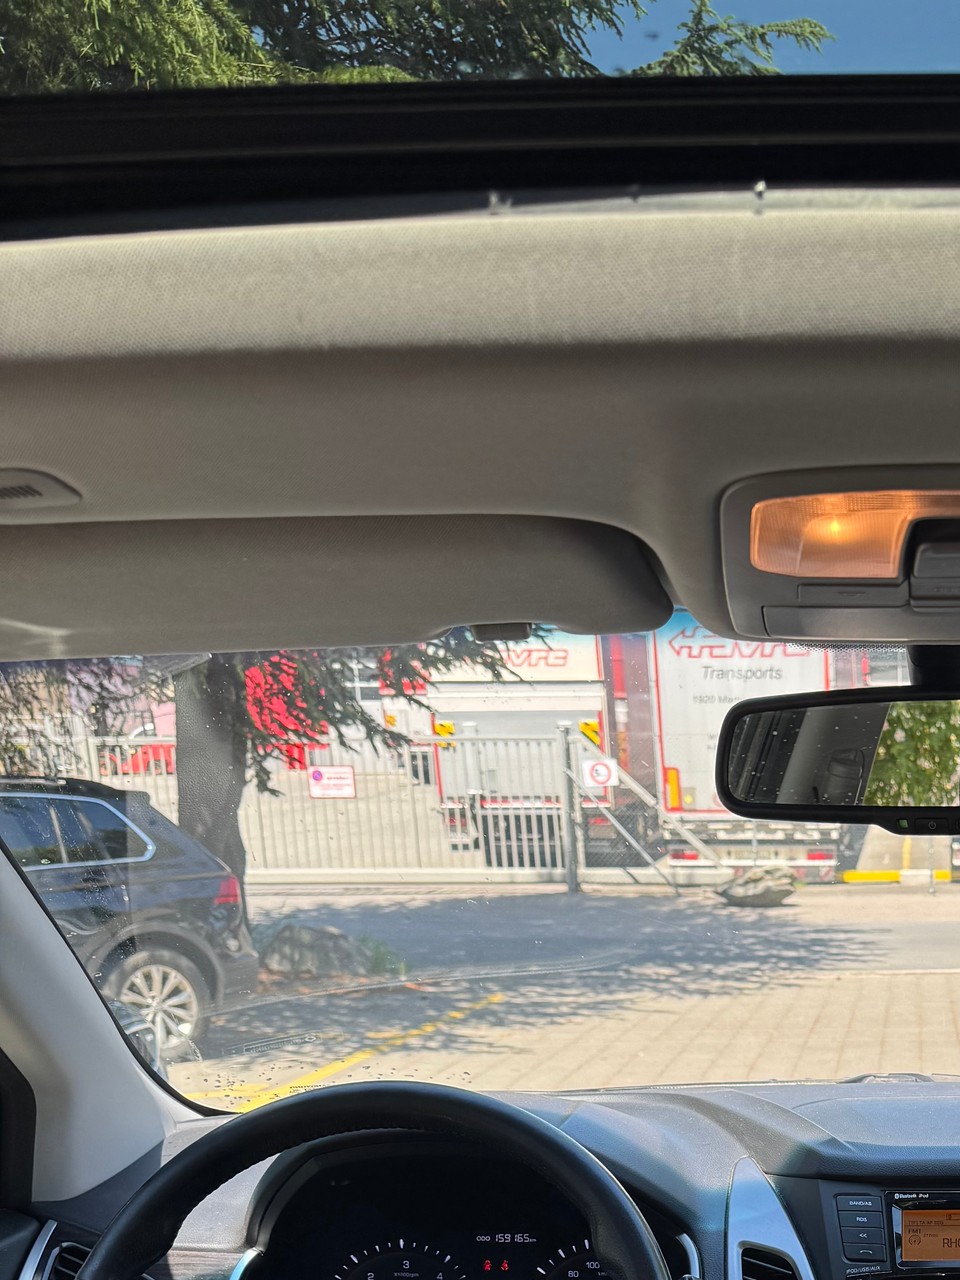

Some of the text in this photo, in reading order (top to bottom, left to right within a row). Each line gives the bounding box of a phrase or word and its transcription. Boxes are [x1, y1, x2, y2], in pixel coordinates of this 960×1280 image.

[702, 666, 783, 681] Transports
[402, 1260, 410, 1269] 3
[585, 1261, 600, 1269] 100
[367, 1272, 375, 1280] 2
[436, 1272, 443, 1280] 4
[567, 1270, 579, 1278] 80
